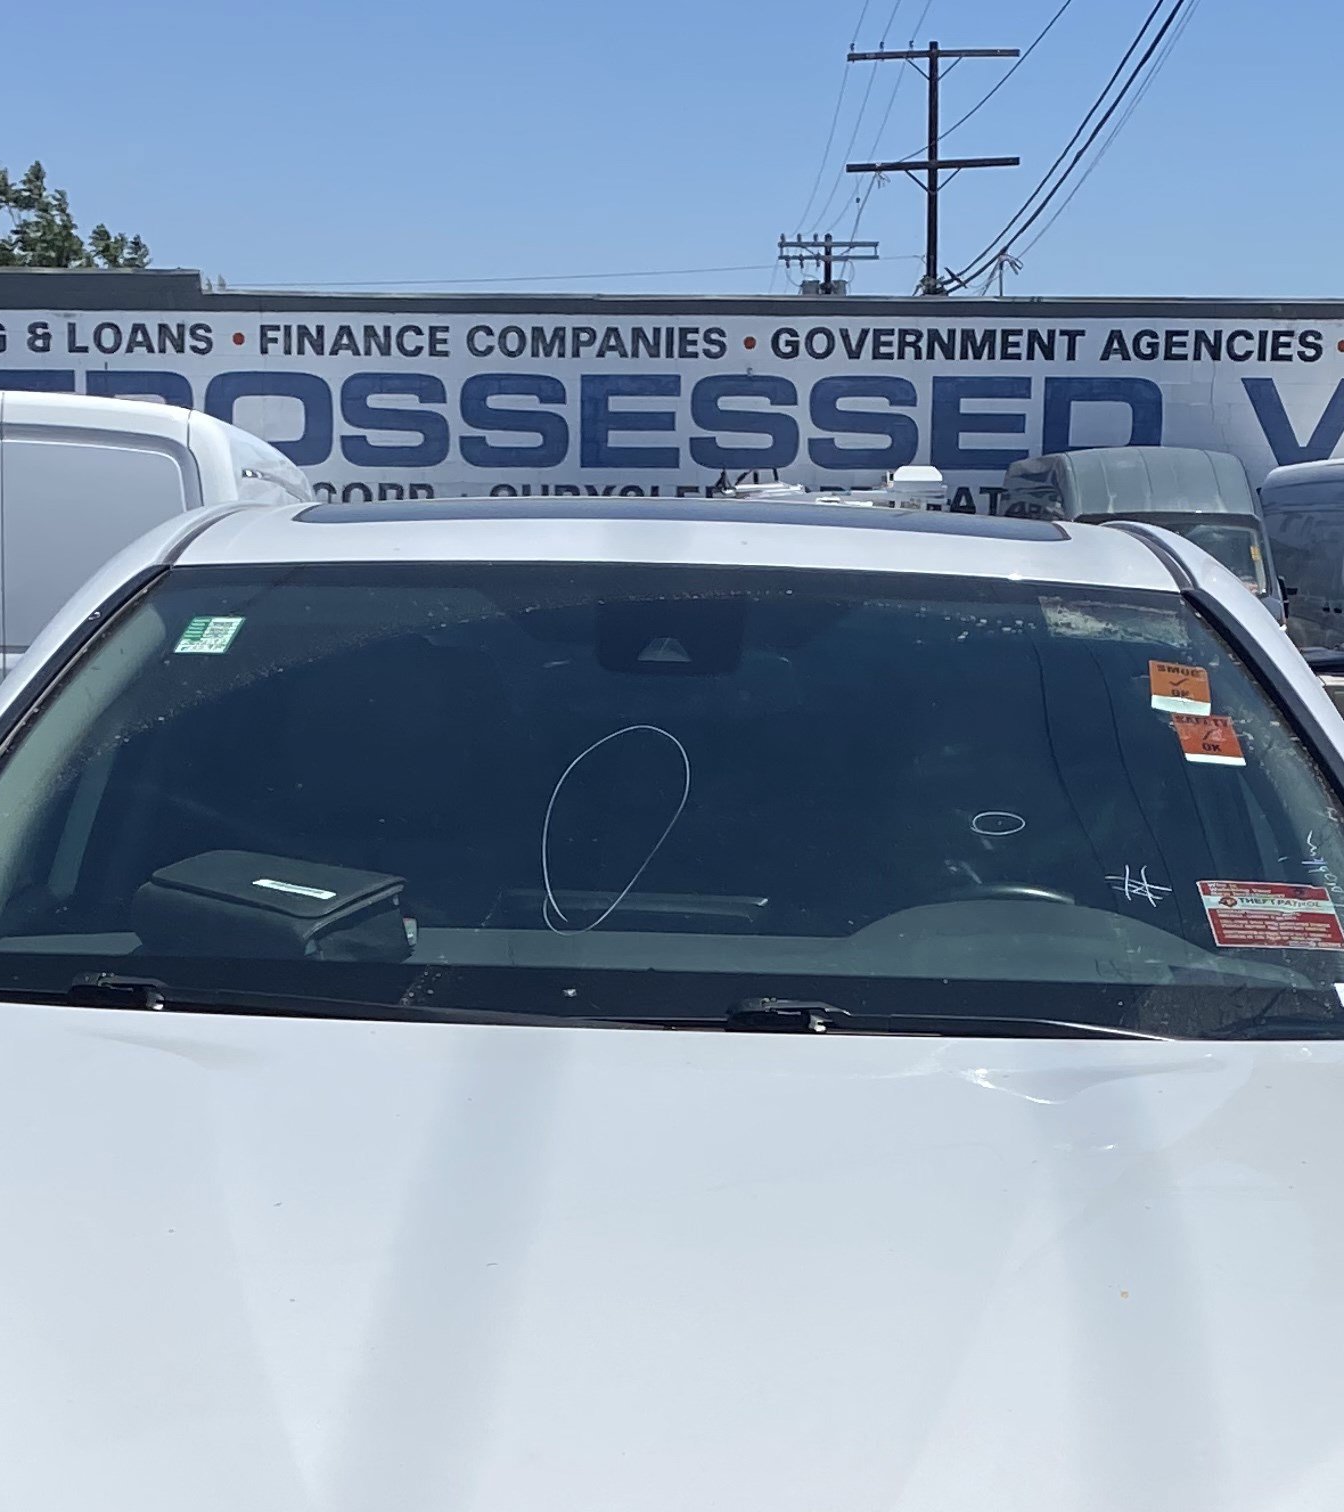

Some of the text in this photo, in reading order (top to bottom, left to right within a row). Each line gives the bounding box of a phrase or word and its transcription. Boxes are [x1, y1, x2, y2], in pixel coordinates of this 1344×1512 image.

[27, 322, 52, 353] &
[68, 322, 213, 355] LOANS
[260, 325, 449, 357] FINANCE
[467, 325, 727, 359] COMPANIES
[771, 327, 1085, 361] GOVERNMENT
[1100, 329, 1323, 362] AGENCIES
[1202, 742, 1222, 753] OK
